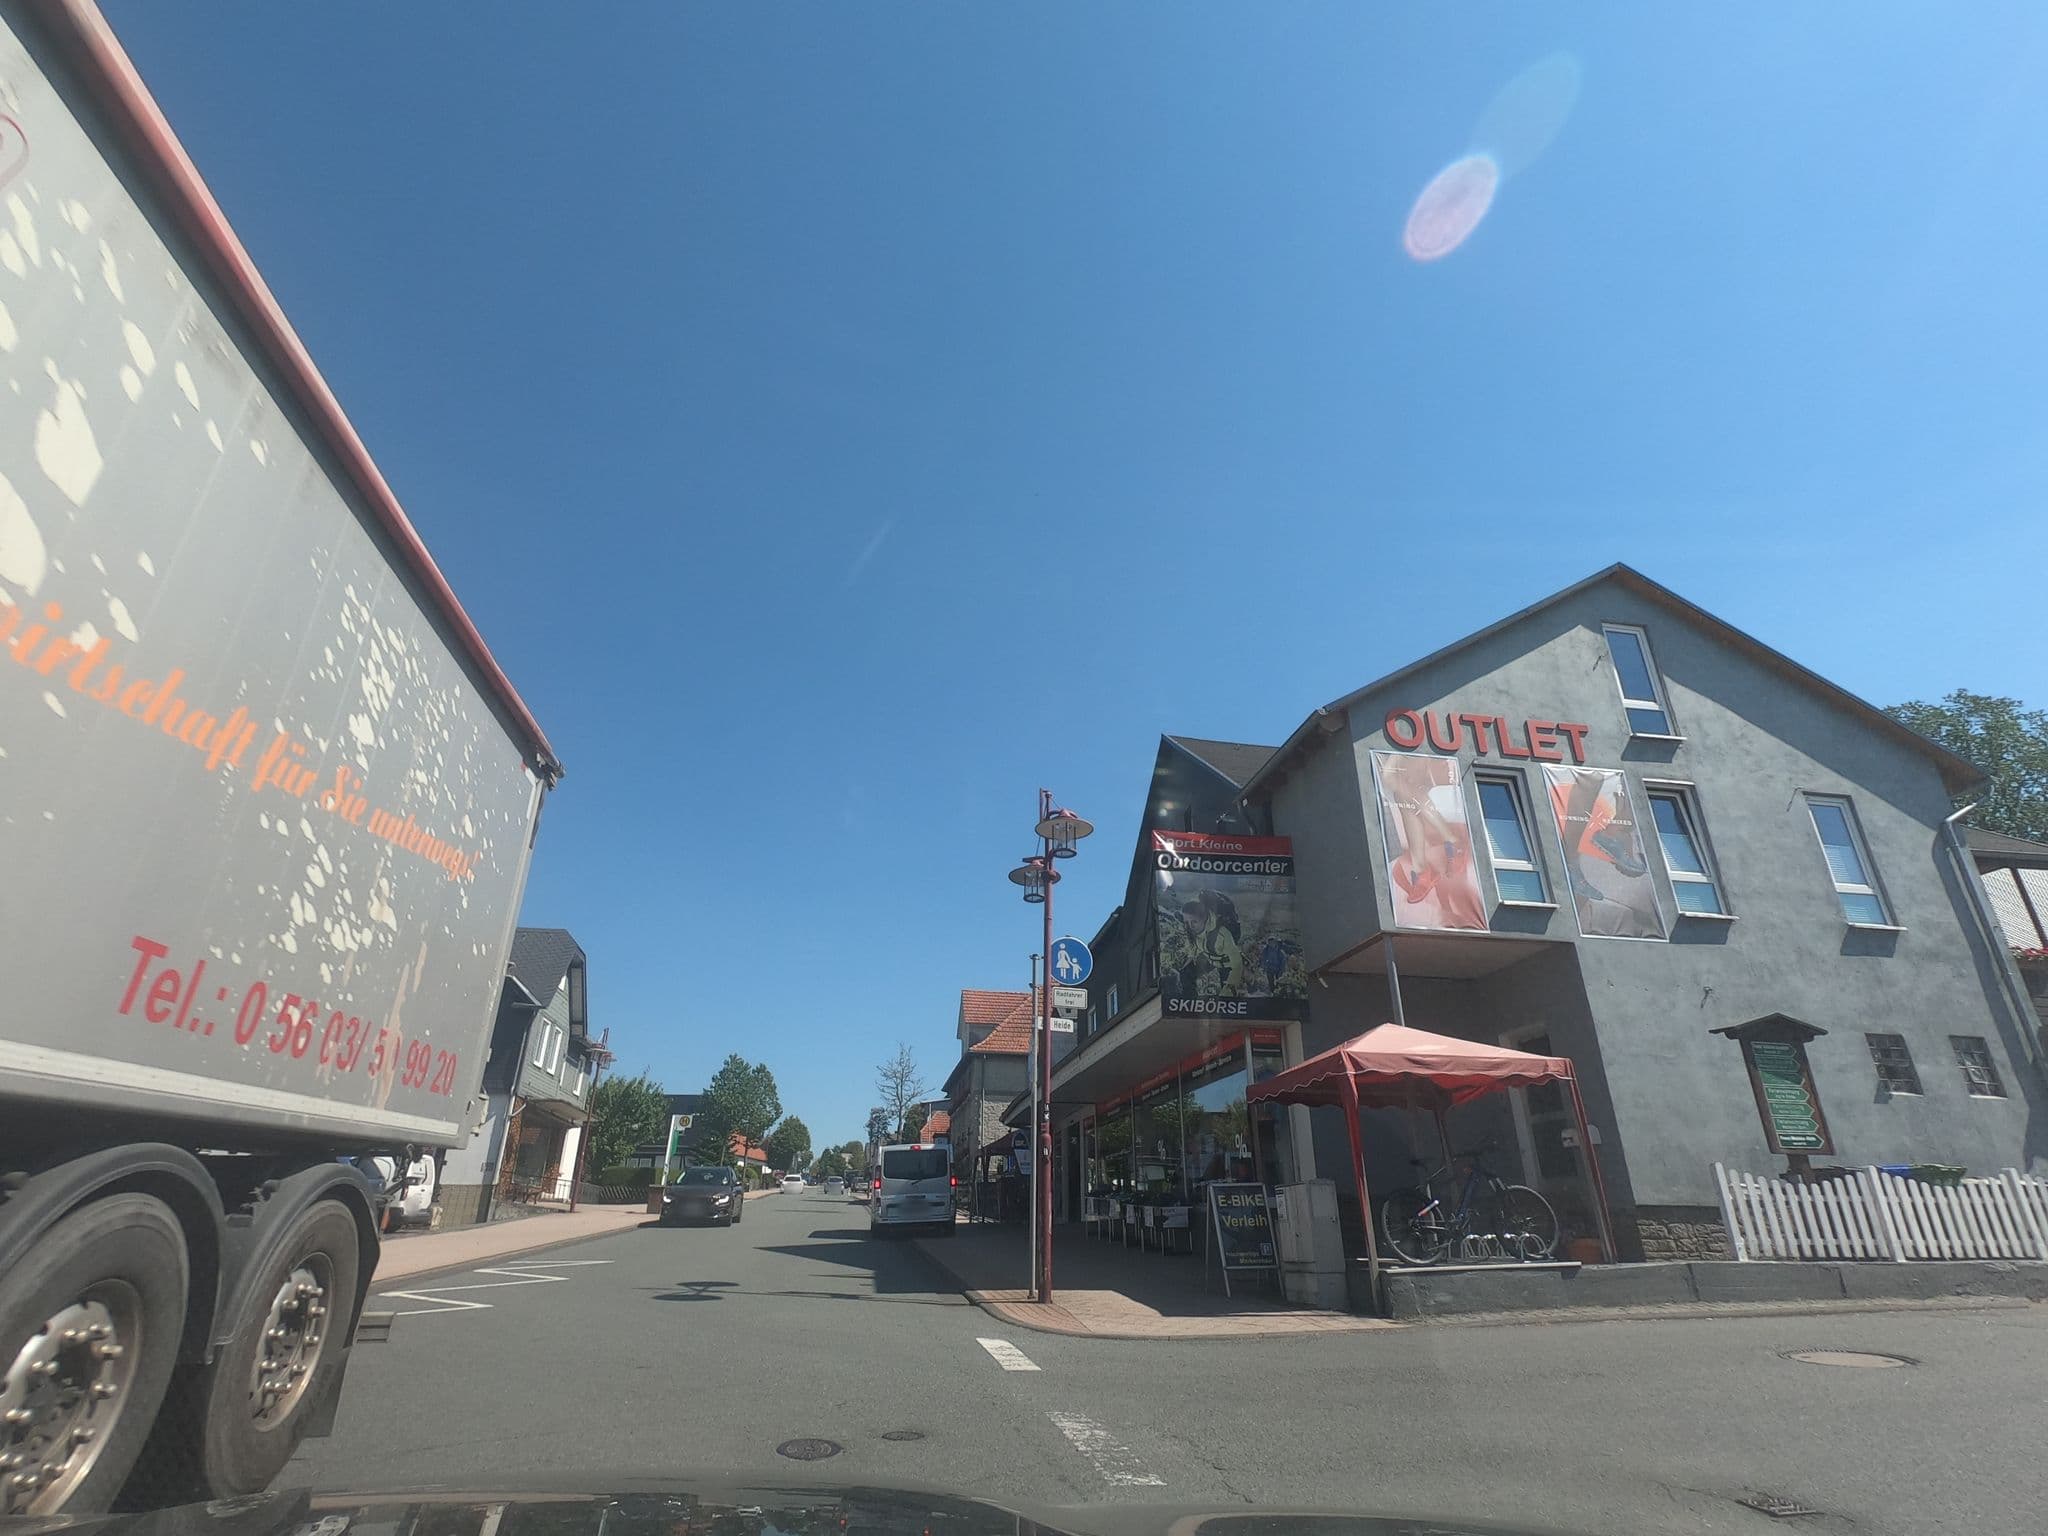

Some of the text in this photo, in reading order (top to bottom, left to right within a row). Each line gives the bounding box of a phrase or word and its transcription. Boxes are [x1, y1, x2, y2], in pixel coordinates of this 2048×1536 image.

[1384, 708, 1590, 764] OUTLET
[252, 732, 318, 797] für
[320, 765, 370, 827] Sie
[1157, 853, 1289, 874] Outdoorcenter
[117, 935, 230, 1037] Tel.:
[234, 980, 268, 1045] 0
[268, 992, 320, 1060] 56
[401, 1038, 432, 1089] 99
[430, 1049, 457, 1096] 20
[1168, 998, 1248, 1015] SKIBÖRSE
[1053, 1020, 1071, 1030] Heide
[1217, 1194, 1265, 1207] E-BIKE
[1221, 1214, 1268, 1228] Verleih
